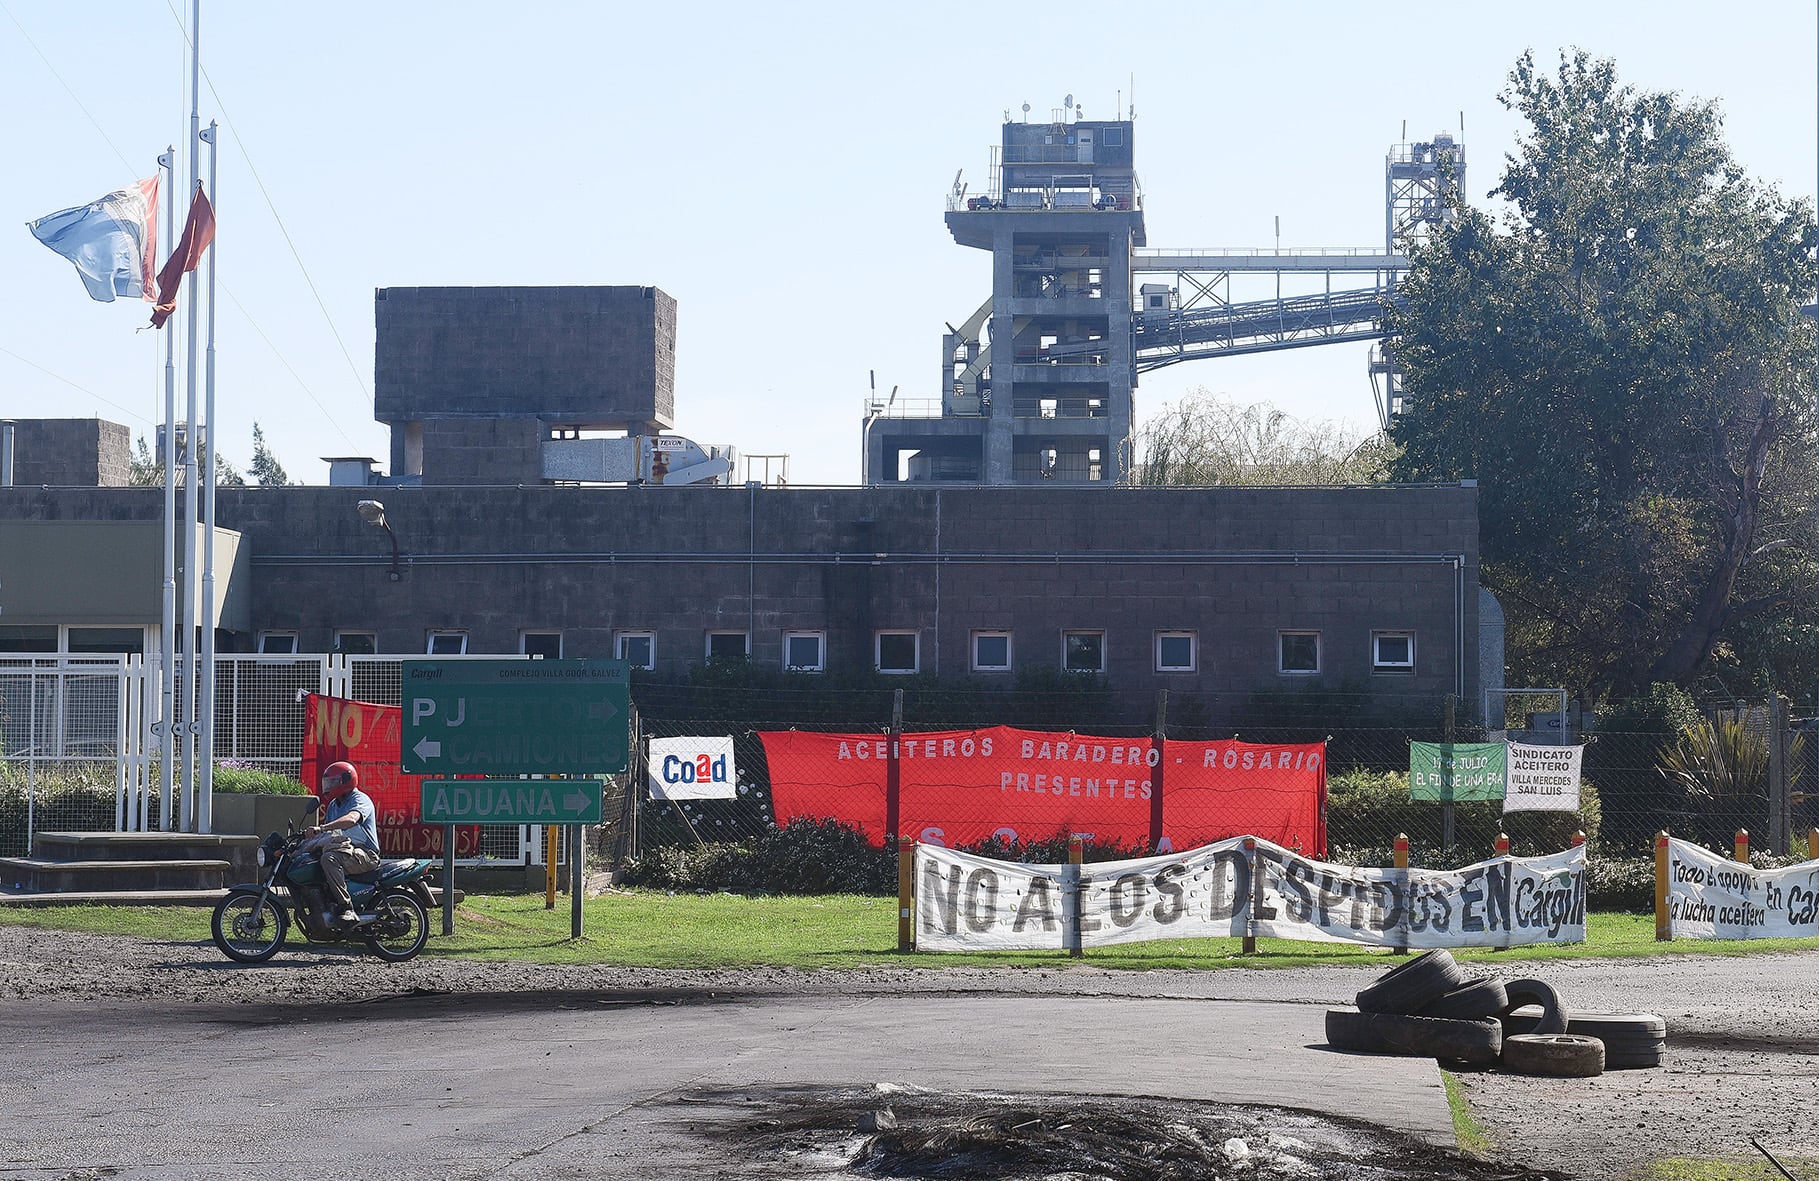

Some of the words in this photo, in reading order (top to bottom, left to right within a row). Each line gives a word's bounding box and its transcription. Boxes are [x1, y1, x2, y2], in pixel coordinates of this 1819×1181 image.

[411, 668, 443, 680] Cargill
[500, 669, 540, 678] COMPLEJO
[542, 669, 563, 678] VILLA
[448, 735, 621, 764] CAMIONES
[838, 737, 994, 760] ACEITEROS
[1021, 740, 1161, 768] BARADERO
[1203, 749, 1321, 772] ROSARIO
[1511, 748, 1573, 760] SINDICATO
[662, 753, 727, 784] Coad
[1459, 756, 1489, 770] JULIO
[1514, 760, 1569, 771] ACEITERO
[1001, 771, 1154, 800] PRESENTES
[1416, 772, 1426, 786] EL
[1429, 773, 1447, 787] FIN
[1450, 774, 1461, 788] DE
[1464, 773, 1483, 787] UNA
[1487, 771, 1504, 786] ERA
[1511, 773, 1531, 784] VILLA
[1532, 775, 1572, 786] MERCEDES
[1517, 785, 1537, 795] SAN
[1540, 786, 1563, 796] LUIS
[431, 788, 557, 815] ADUANA
[923, 859, 999, 935] NO
[1012, 876, 1057, 932] A
[1074, 864, 1187, 932] LOS
[1209, 849, 1454, 934] DESPIDOS
[1459, 861, 1513, 932] EN
[1514, 870, 1586, 938] Cargill
[1717, 871, 1752, 895] apoyo
[1765, 881, 1783, 910] En
[1680, 896, 1716, 923] lucha
[1719, 900, 1765, 927] aceitera
